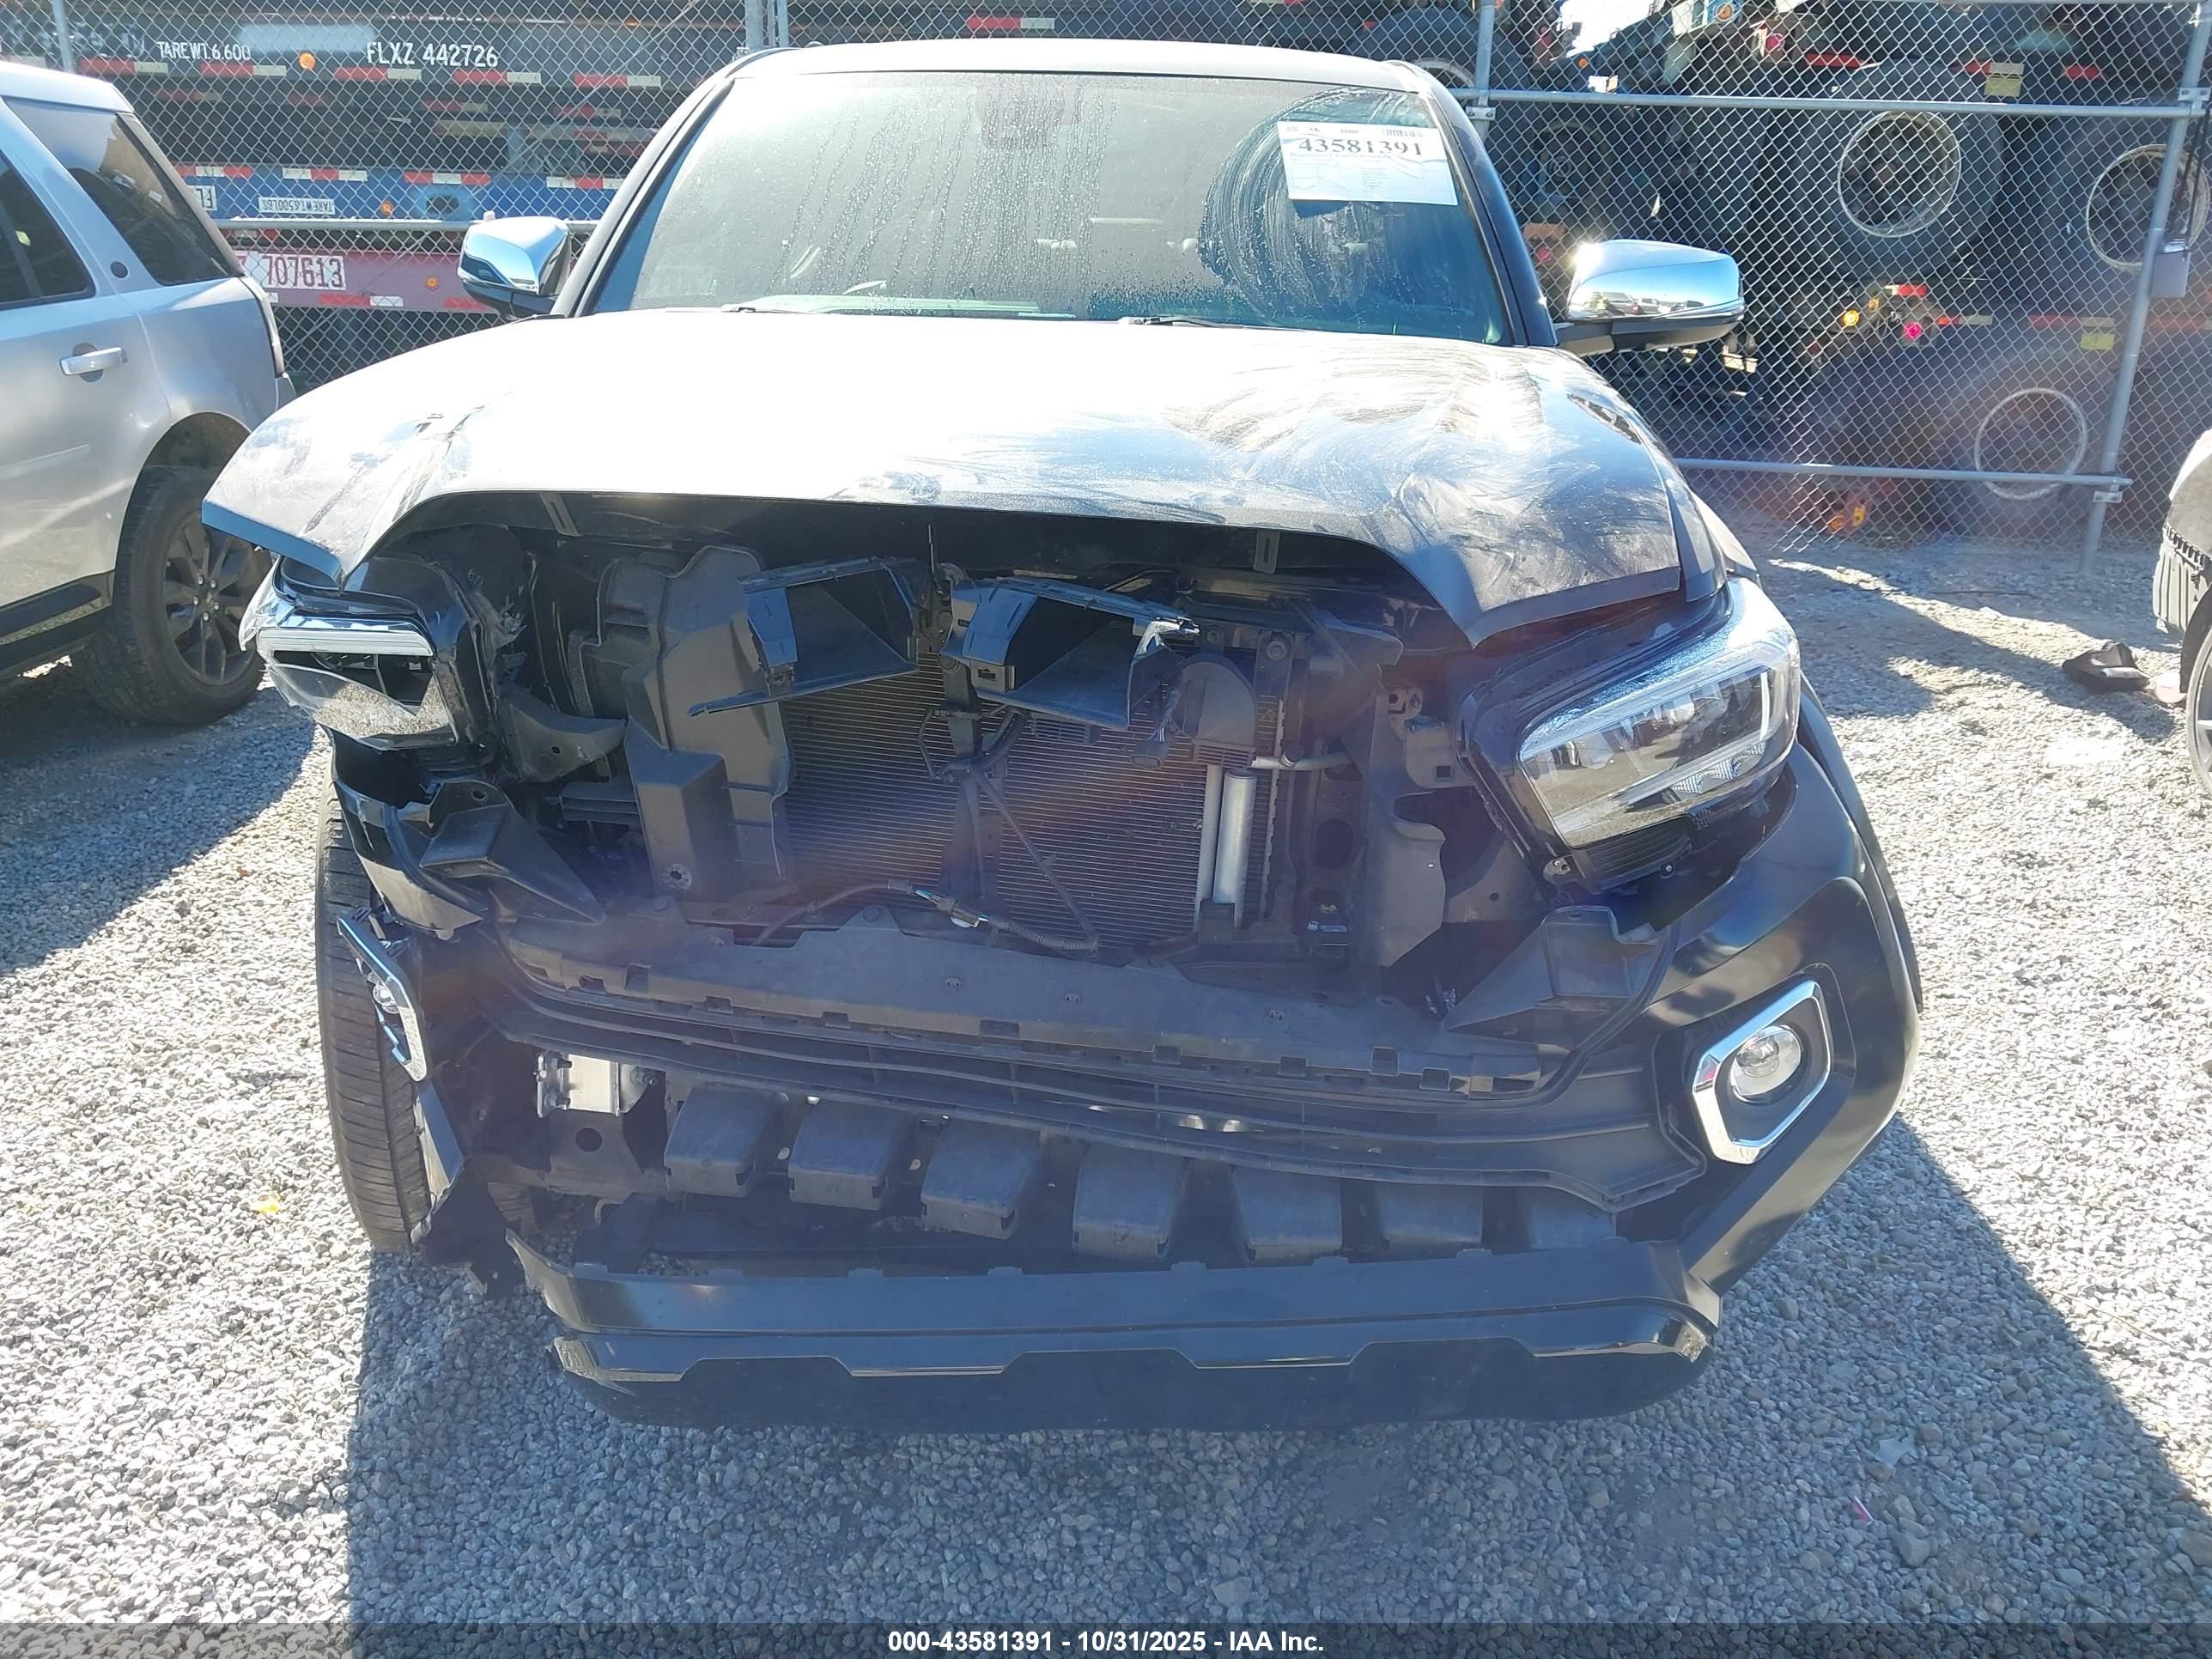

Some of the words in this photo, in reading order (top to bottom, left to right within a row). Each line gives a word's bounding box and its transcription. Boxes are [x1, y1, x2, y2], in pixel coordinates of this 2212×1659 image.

[366, 41, 416, 65] FLXZ
[422, 43, 499, 68] 442726
[1297, 137, 1423, 155] 43581391
[261, 255, 344, 288] 707613
